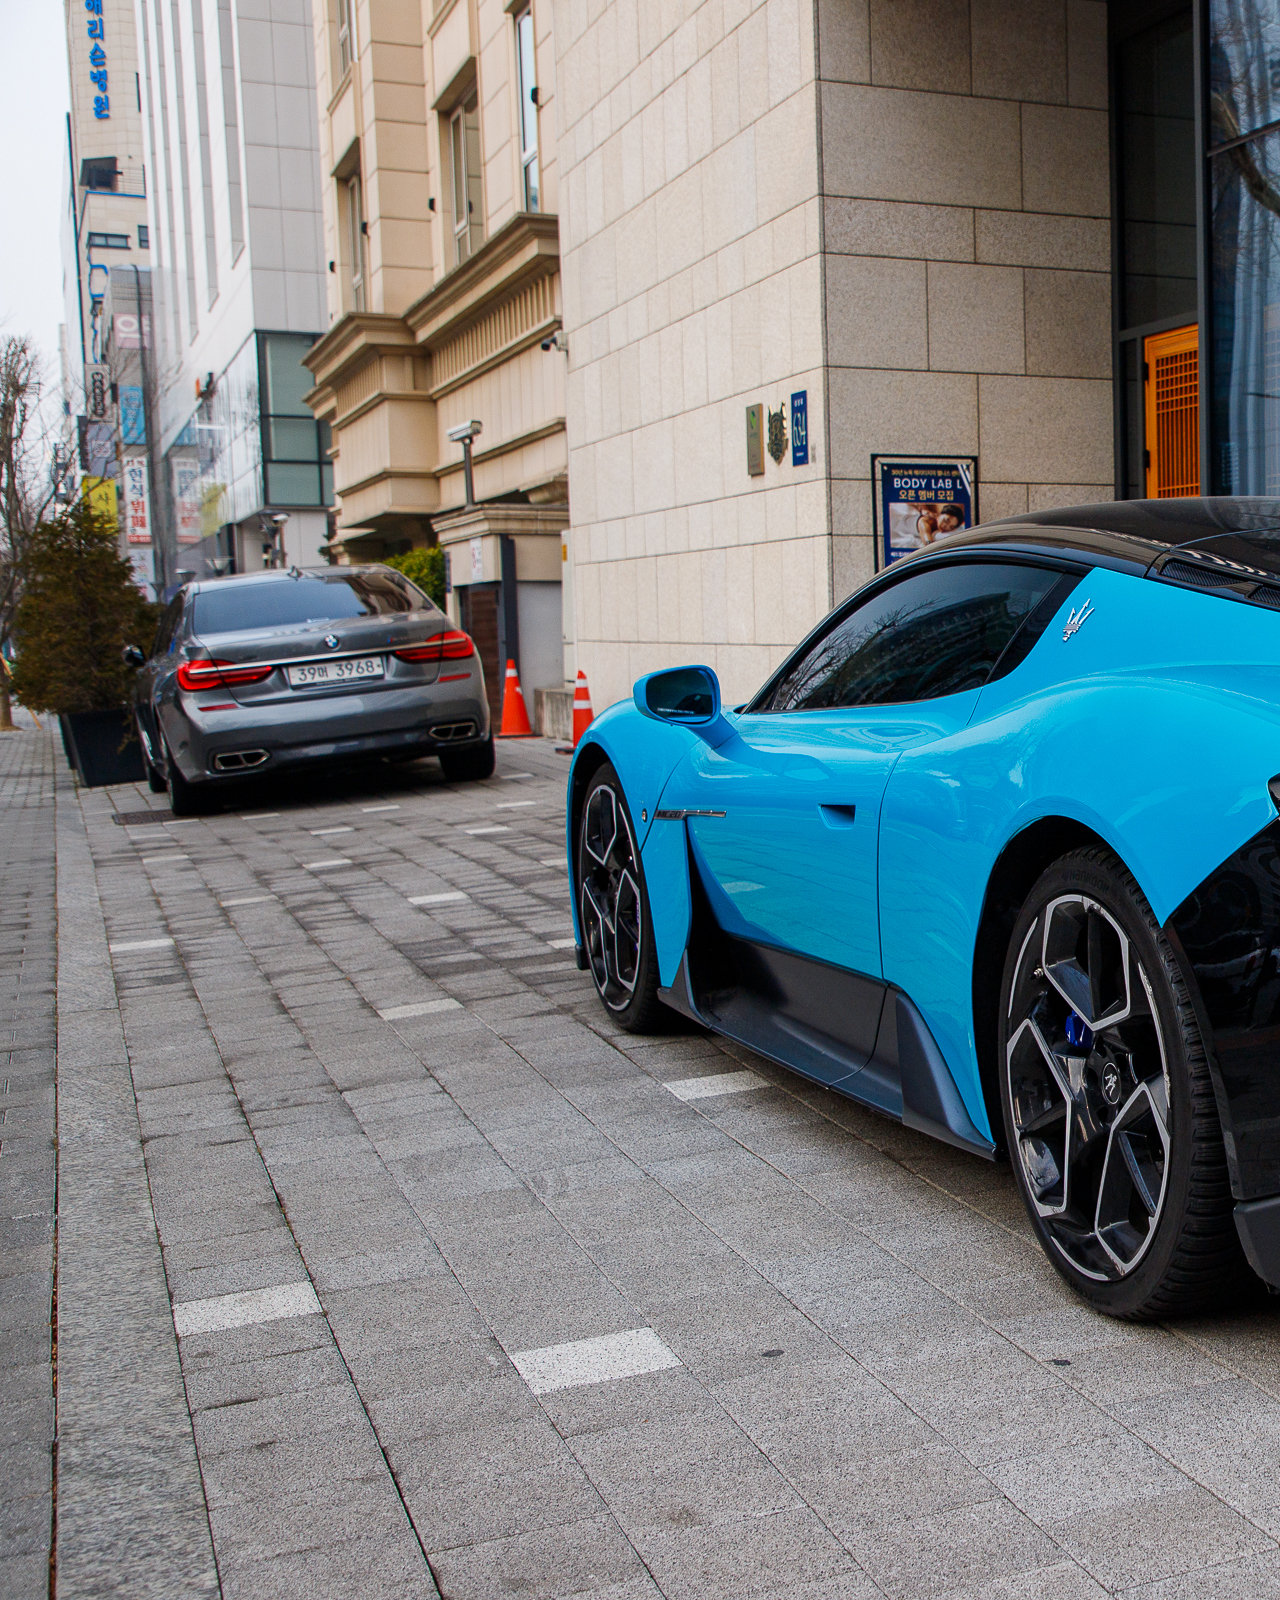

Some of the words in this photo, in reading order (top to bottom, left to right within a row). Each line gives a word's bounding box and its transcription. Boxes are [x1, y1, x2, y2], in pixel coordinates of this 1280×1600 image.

[793, 411, 806, 448] 634
[893, 477, 927, 489] BODY
[931, 478, 953, 489] LAB
[899, 489, 916, 500] 오픈
[918, 489, 935, 501] 멤버
[937, 490, 954, 501] 모집
[297, 666, 328, 682] 39머
[335, 660, 375, 677] 3968
